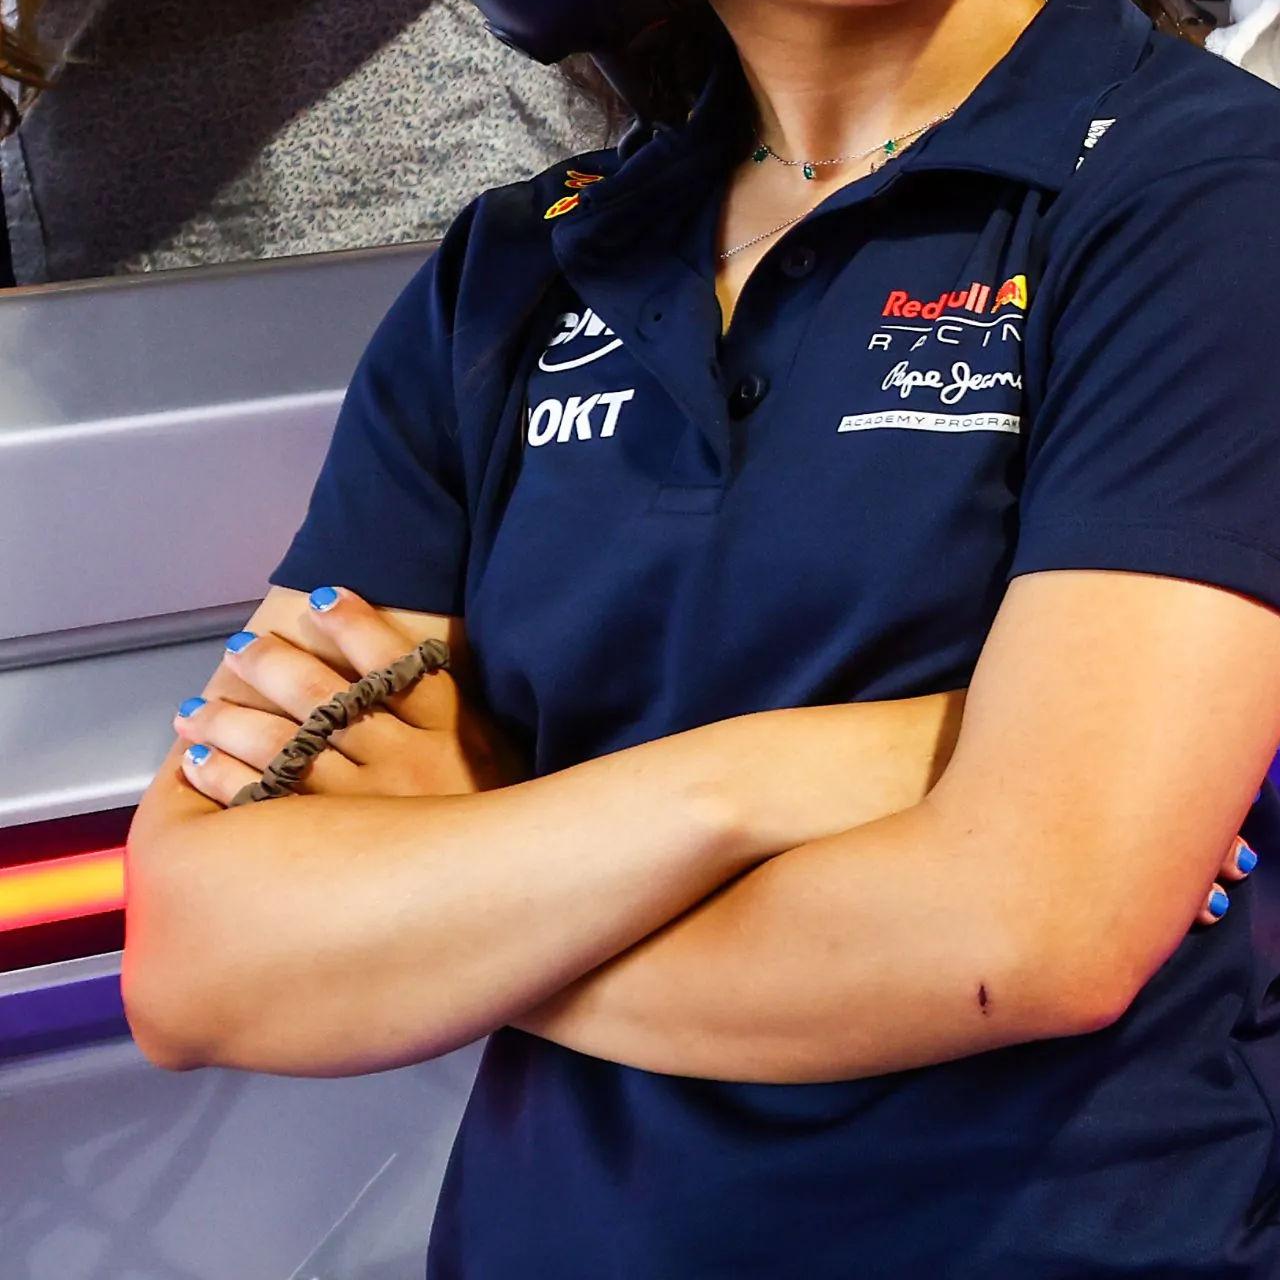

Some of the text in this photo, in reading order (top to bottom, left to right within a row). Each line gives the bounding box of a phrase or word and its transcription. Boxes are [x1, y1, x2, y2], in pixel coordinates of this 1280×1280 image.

[882, 282, 991, 321] Red ull
[868, 323, 1022, 351] RACIN
[881, 361, 943, 399] Pepe
[528, 389, 635, 447] OKT
[843, 414, 1020, 428] ACADEMY PROGRAM
